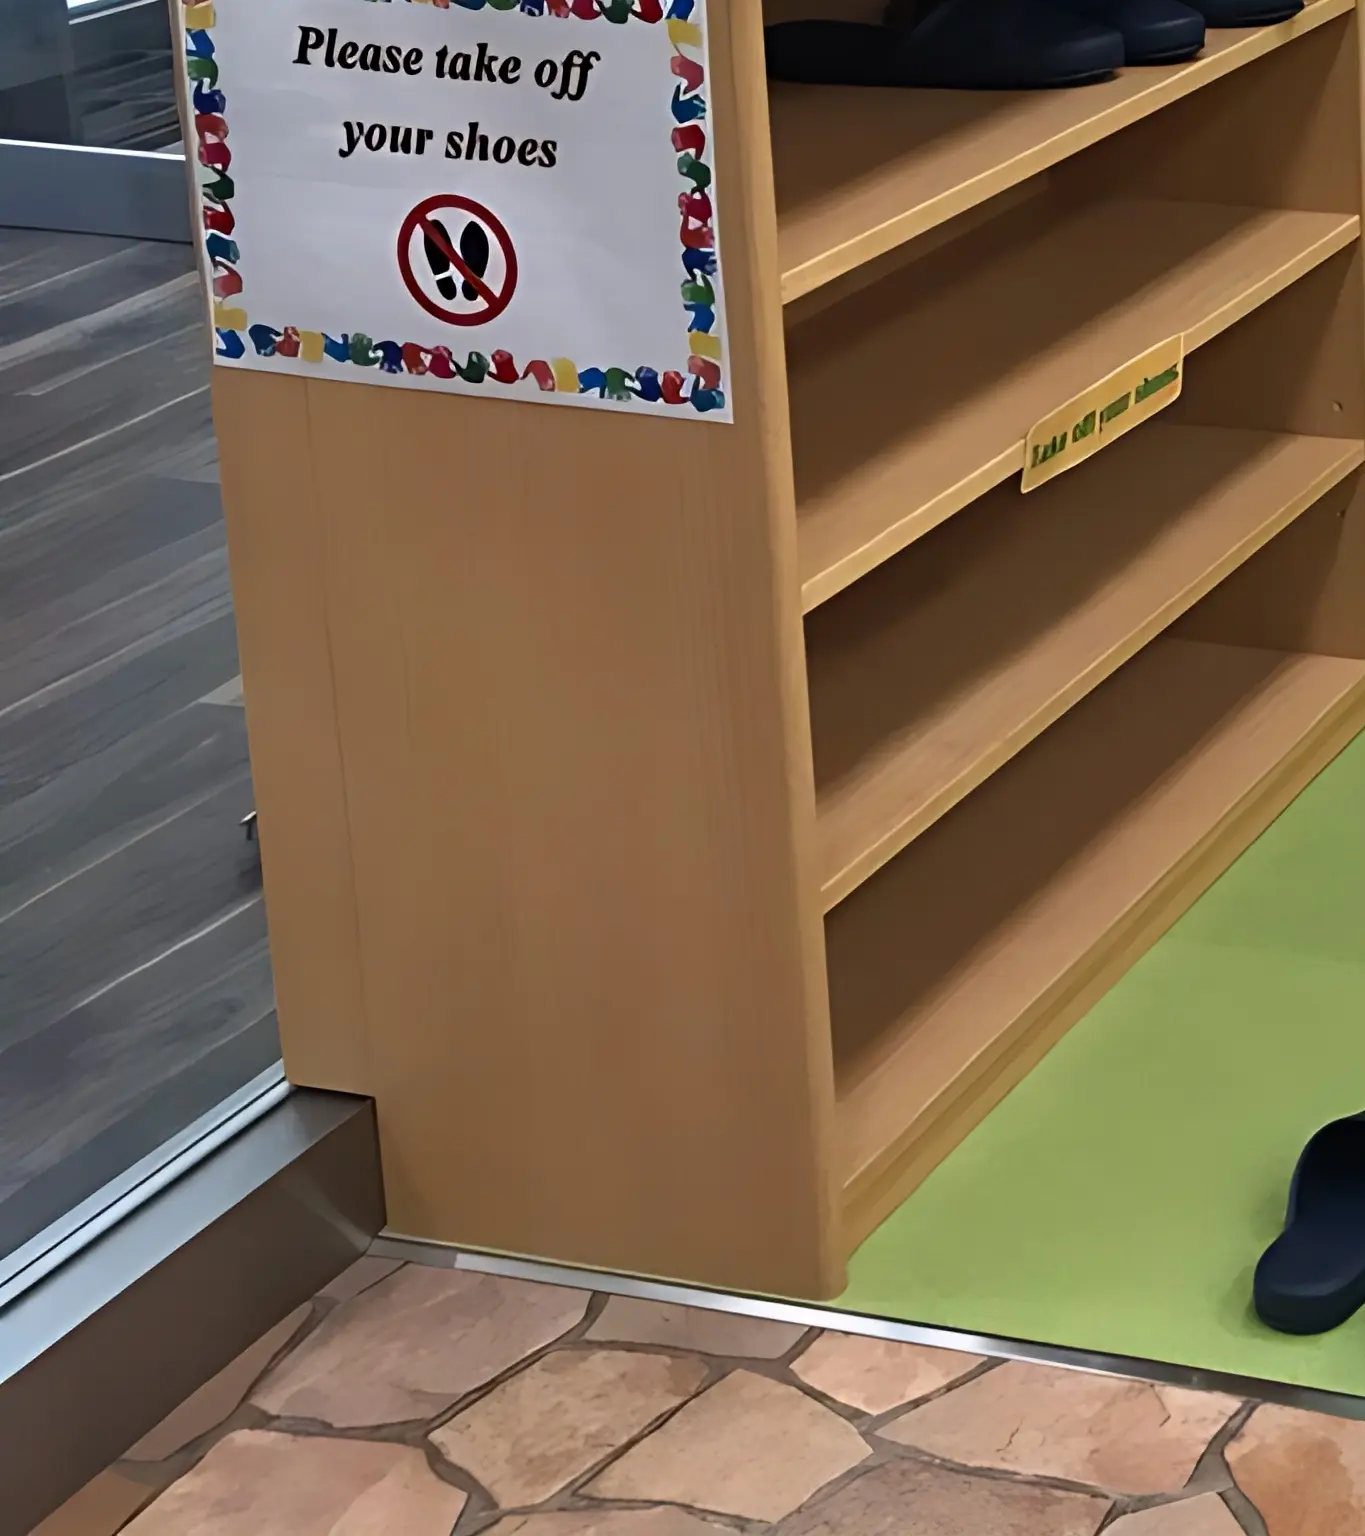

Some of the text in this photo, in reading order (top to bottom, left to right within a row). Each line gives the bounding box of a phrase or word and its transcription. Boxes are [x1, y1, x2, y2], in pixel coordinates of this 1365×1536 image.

[292, 24, 602, 102] Please take off
[338, 120, 559, 168] your shoes
